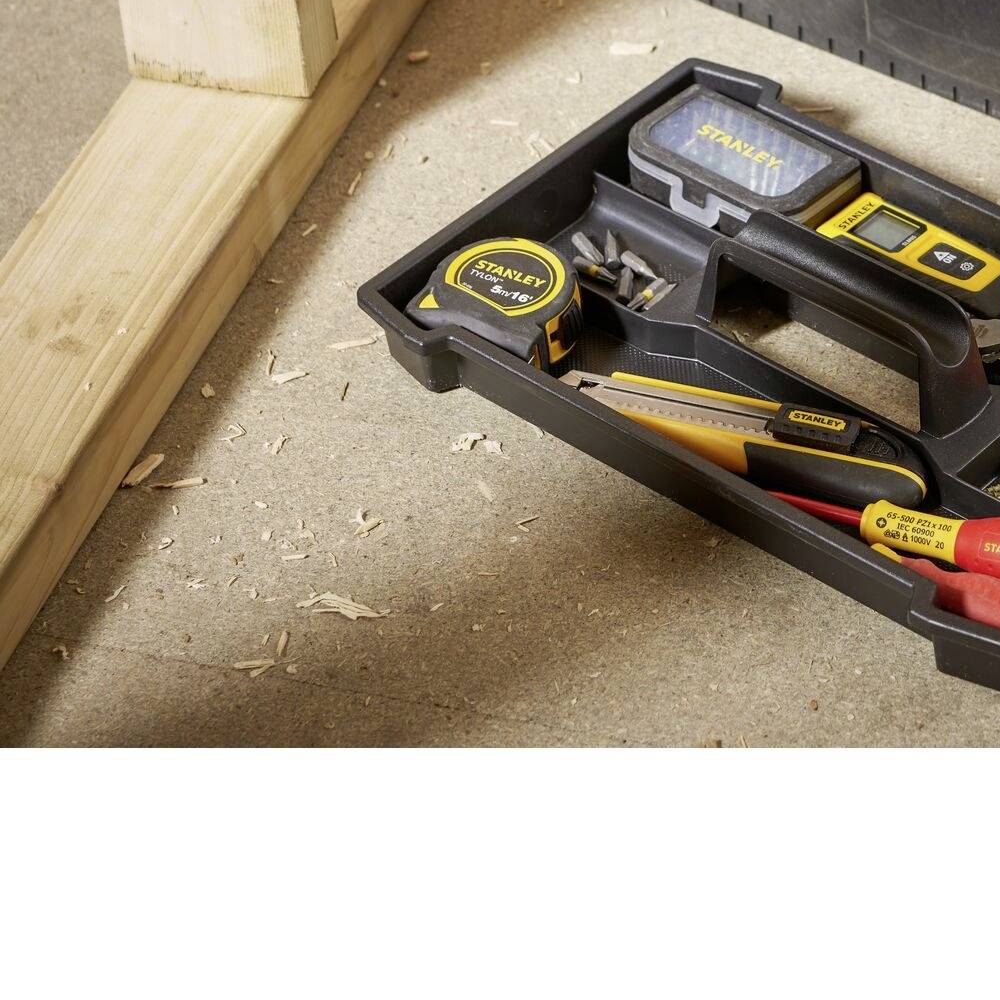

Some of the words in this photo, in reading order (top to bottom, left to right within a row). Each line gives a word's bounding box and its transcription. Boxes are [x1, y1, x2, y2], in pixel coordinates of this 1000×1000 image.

[696, 123, 784, 170] STANLEY
[838, 201, 876, 230] STANLEY
[474, 259, 547, 288] STANLEY
[792, 411, 842, 429] STANLEY
[886, 511, 916, 524] 65-500
[896, 522, 911, 532] IEC
[911, 526, 935, 538] 60900
[910, 535, 932, 546] 1000V
